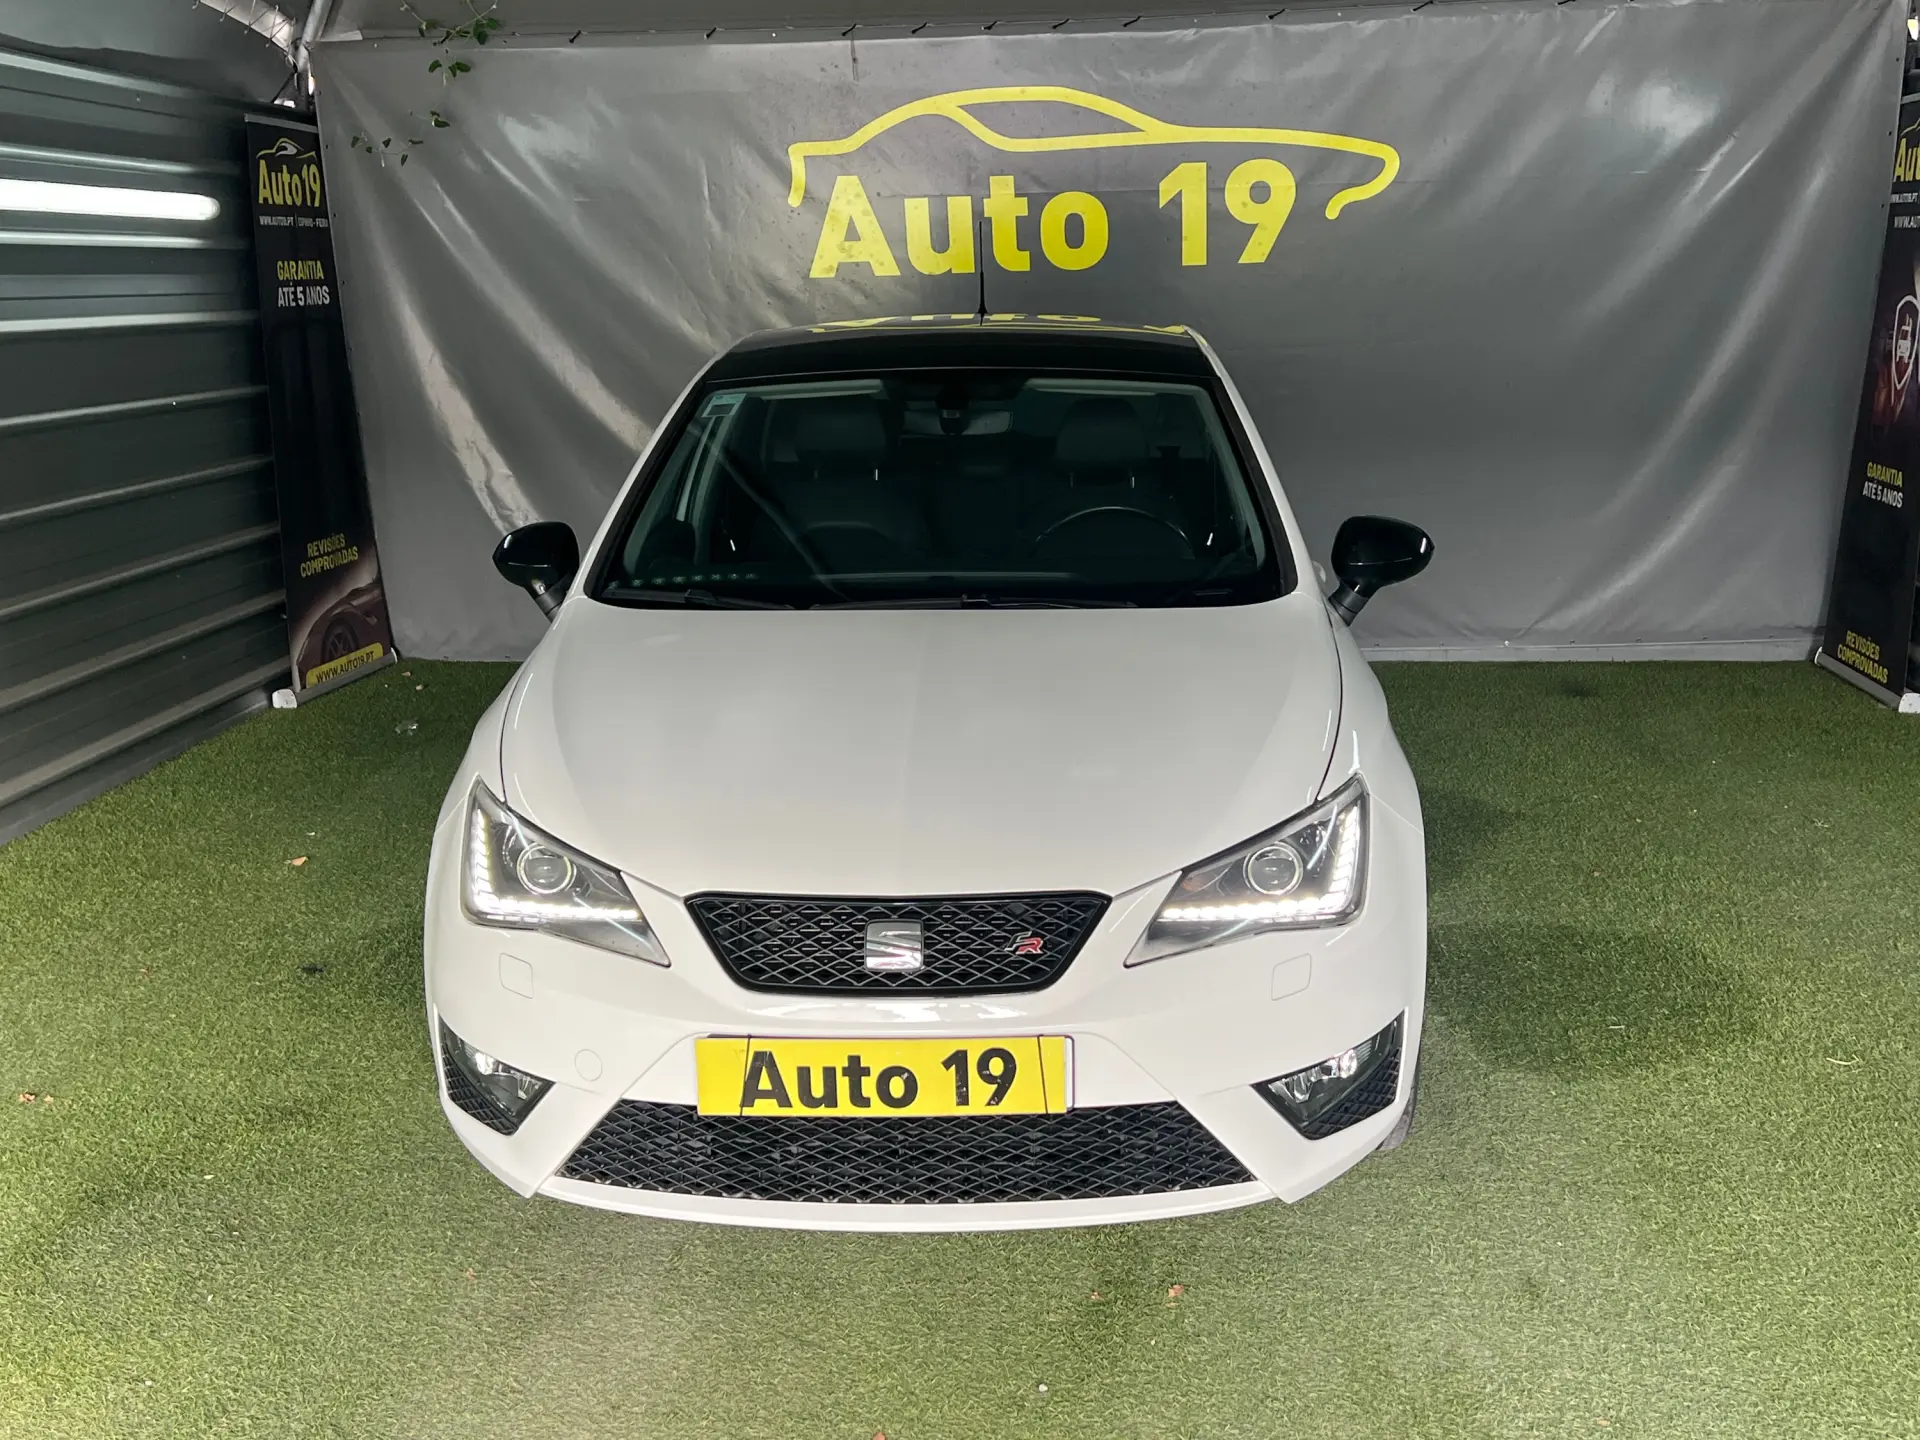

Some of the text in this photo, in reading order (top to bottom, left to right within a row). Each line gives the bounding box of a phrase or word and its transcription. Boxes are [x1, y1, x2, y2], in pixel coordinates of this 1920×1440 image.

[809, 158, 1296, 279] Auto 19
[276, 260, 324, 281] GARANTIA
[277, 282, 330, 307] ATÉ 5 ANOS
[1867, 461, 1903, 488] GARANTIA
[1862, 479, 1904, 509] ATÉ 5 ANOS
[307, 534, 346, 557] REVISÕES
[300, 547, 358, 577] COMPROVADAS
[1846, 630, 1880, 660] REVISÕES
[316, 652, 374, 683] WWW.AUTO19.PT
[1837, 644, 1889, 684] COMPROVADAS
[739, 1047, 1018, 1109] Auto 19
